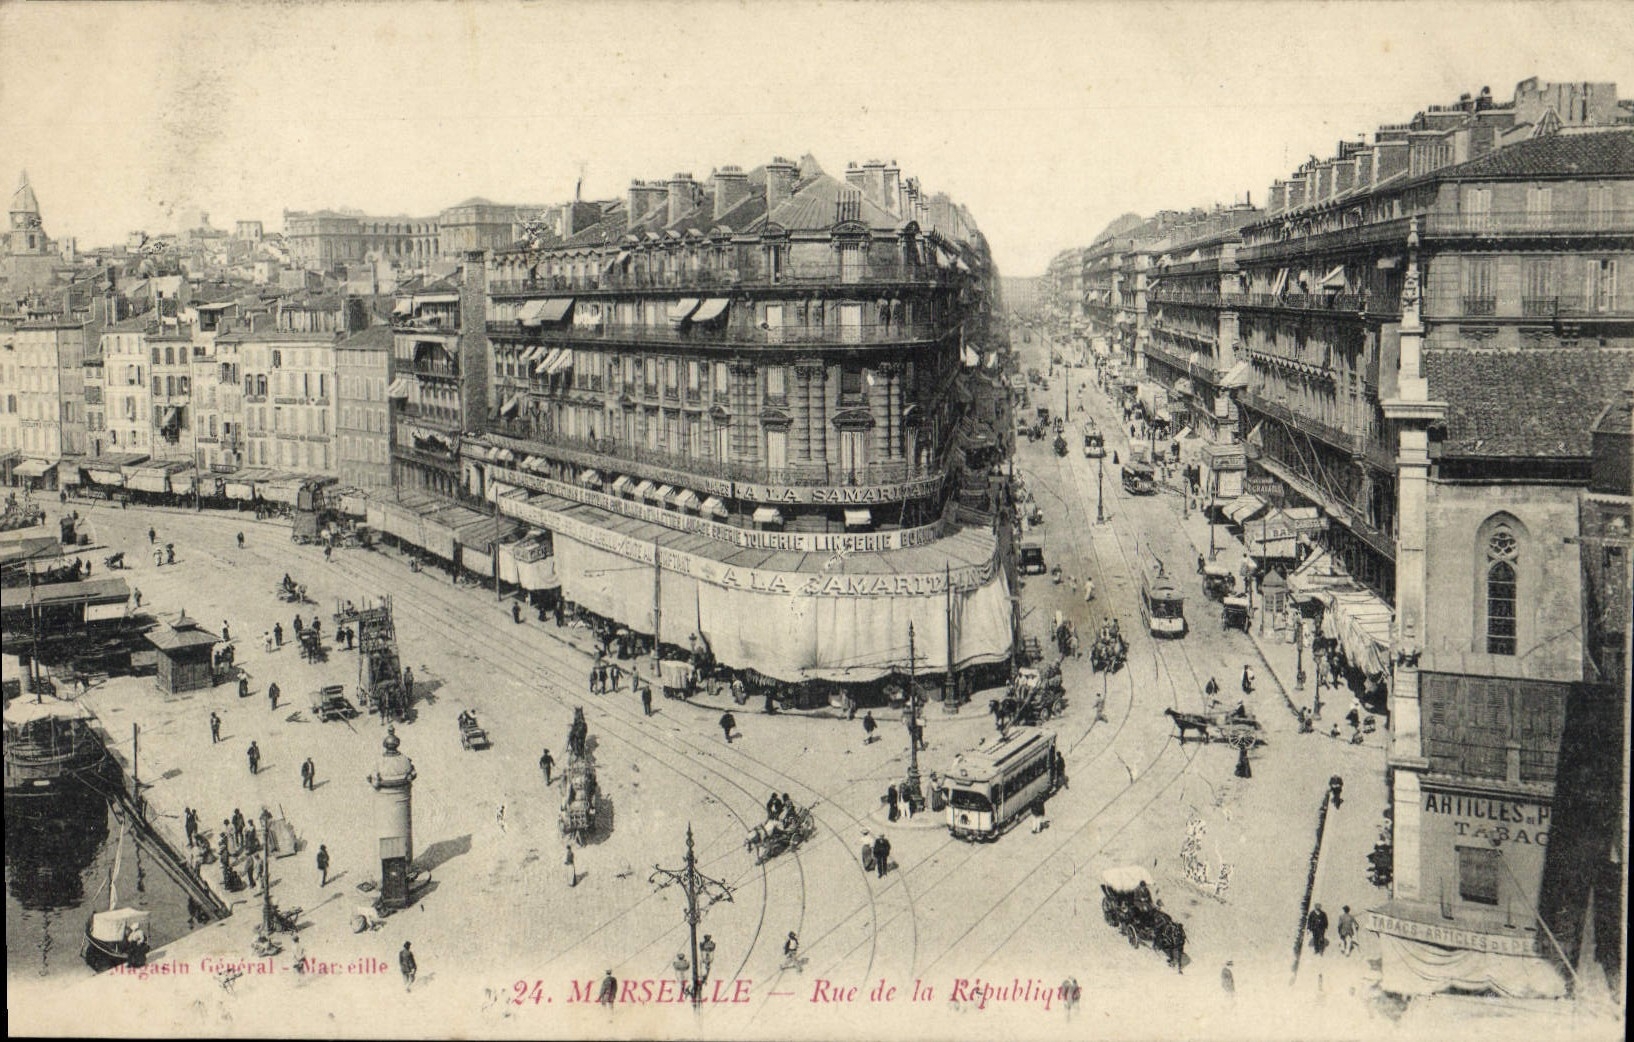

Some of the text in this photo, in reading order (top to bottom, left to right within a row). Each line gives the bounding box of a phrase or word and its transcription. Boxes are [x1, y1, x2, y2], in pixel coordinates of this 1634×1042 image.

[744, 487, 758, 500] A
[766, 488, 802, 503] LA
[744, 532, 804, 550] TOILERIE
[815, 534, 892, 551] LINGERIE
[722, 567, 741, 587] A
[750, 571, 791, 593] LA
[1425, 793, 1524, 823] ARTICLES
[1371, 915, 1417, 936] TABACS
[1426, 929, 1487, 949] ARTICLES
